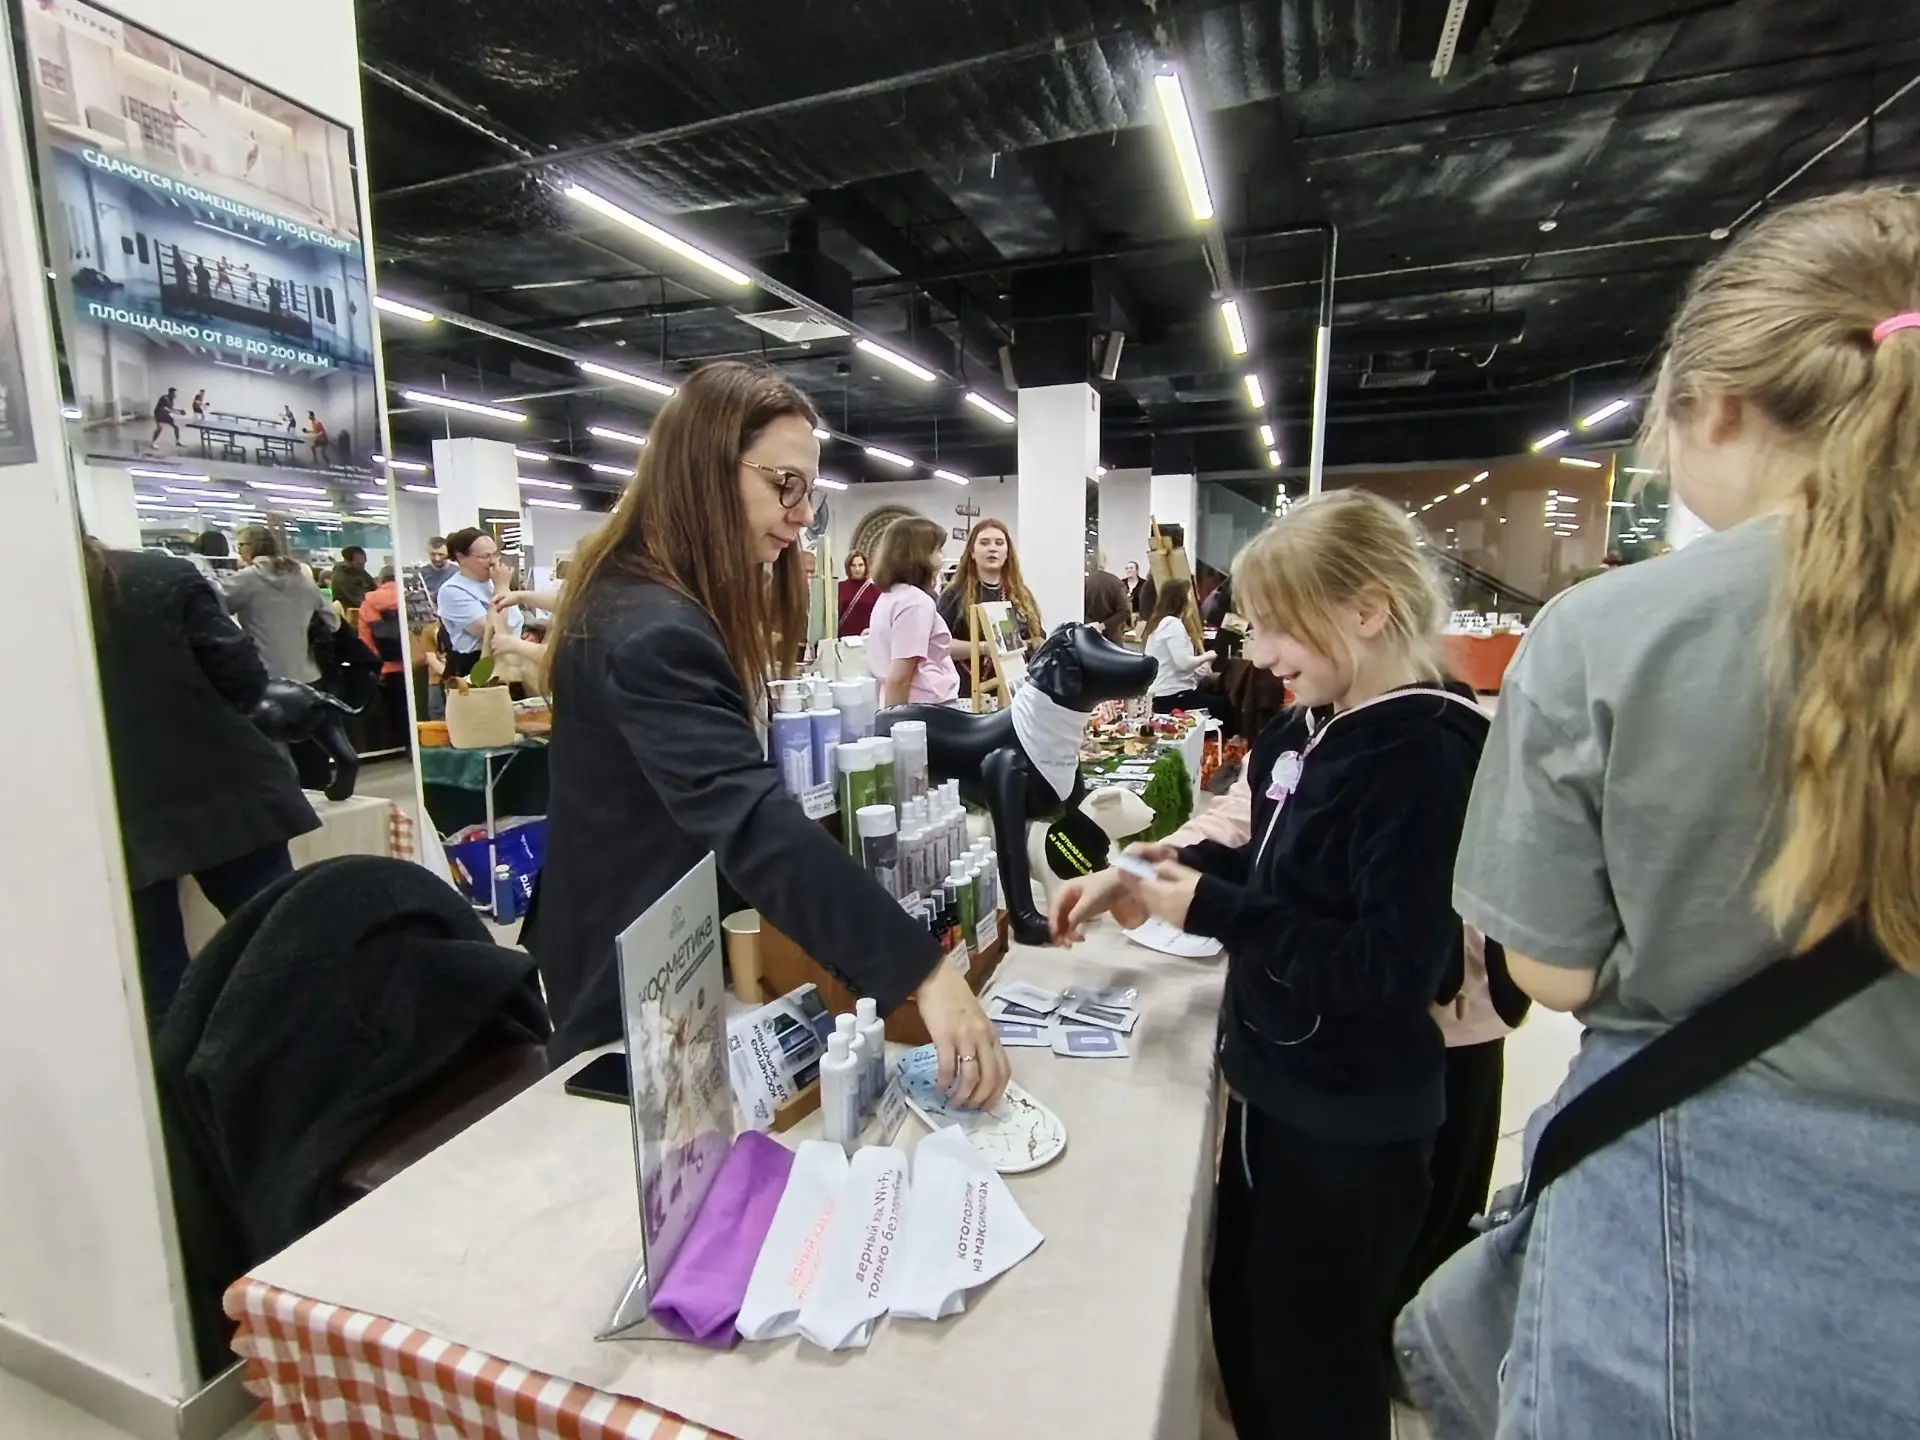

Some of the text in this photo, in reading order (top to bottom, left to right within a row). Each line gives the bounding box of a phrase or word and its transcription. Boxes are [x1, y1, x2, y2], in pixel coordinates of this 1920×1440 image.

[82, 149, 352, 252] СДАЮТСЯ ПОМЕЩЕНИЯ ПОД СПОРТ
[89, 302, 199, 339] ПЛОЩАДЬЮ
[203, 331, 223, 344] ОТ
[226, 336, 243, 349] 88
[246, 340, 268, 355] ДО
[270, 345, 296, 361] 200
[856, 1224, 880, 1283] верный
[868, 1245, 890, 1299] только
[881, 1216, 899, 1241] без
[973, 1258, 983, 1273] на
